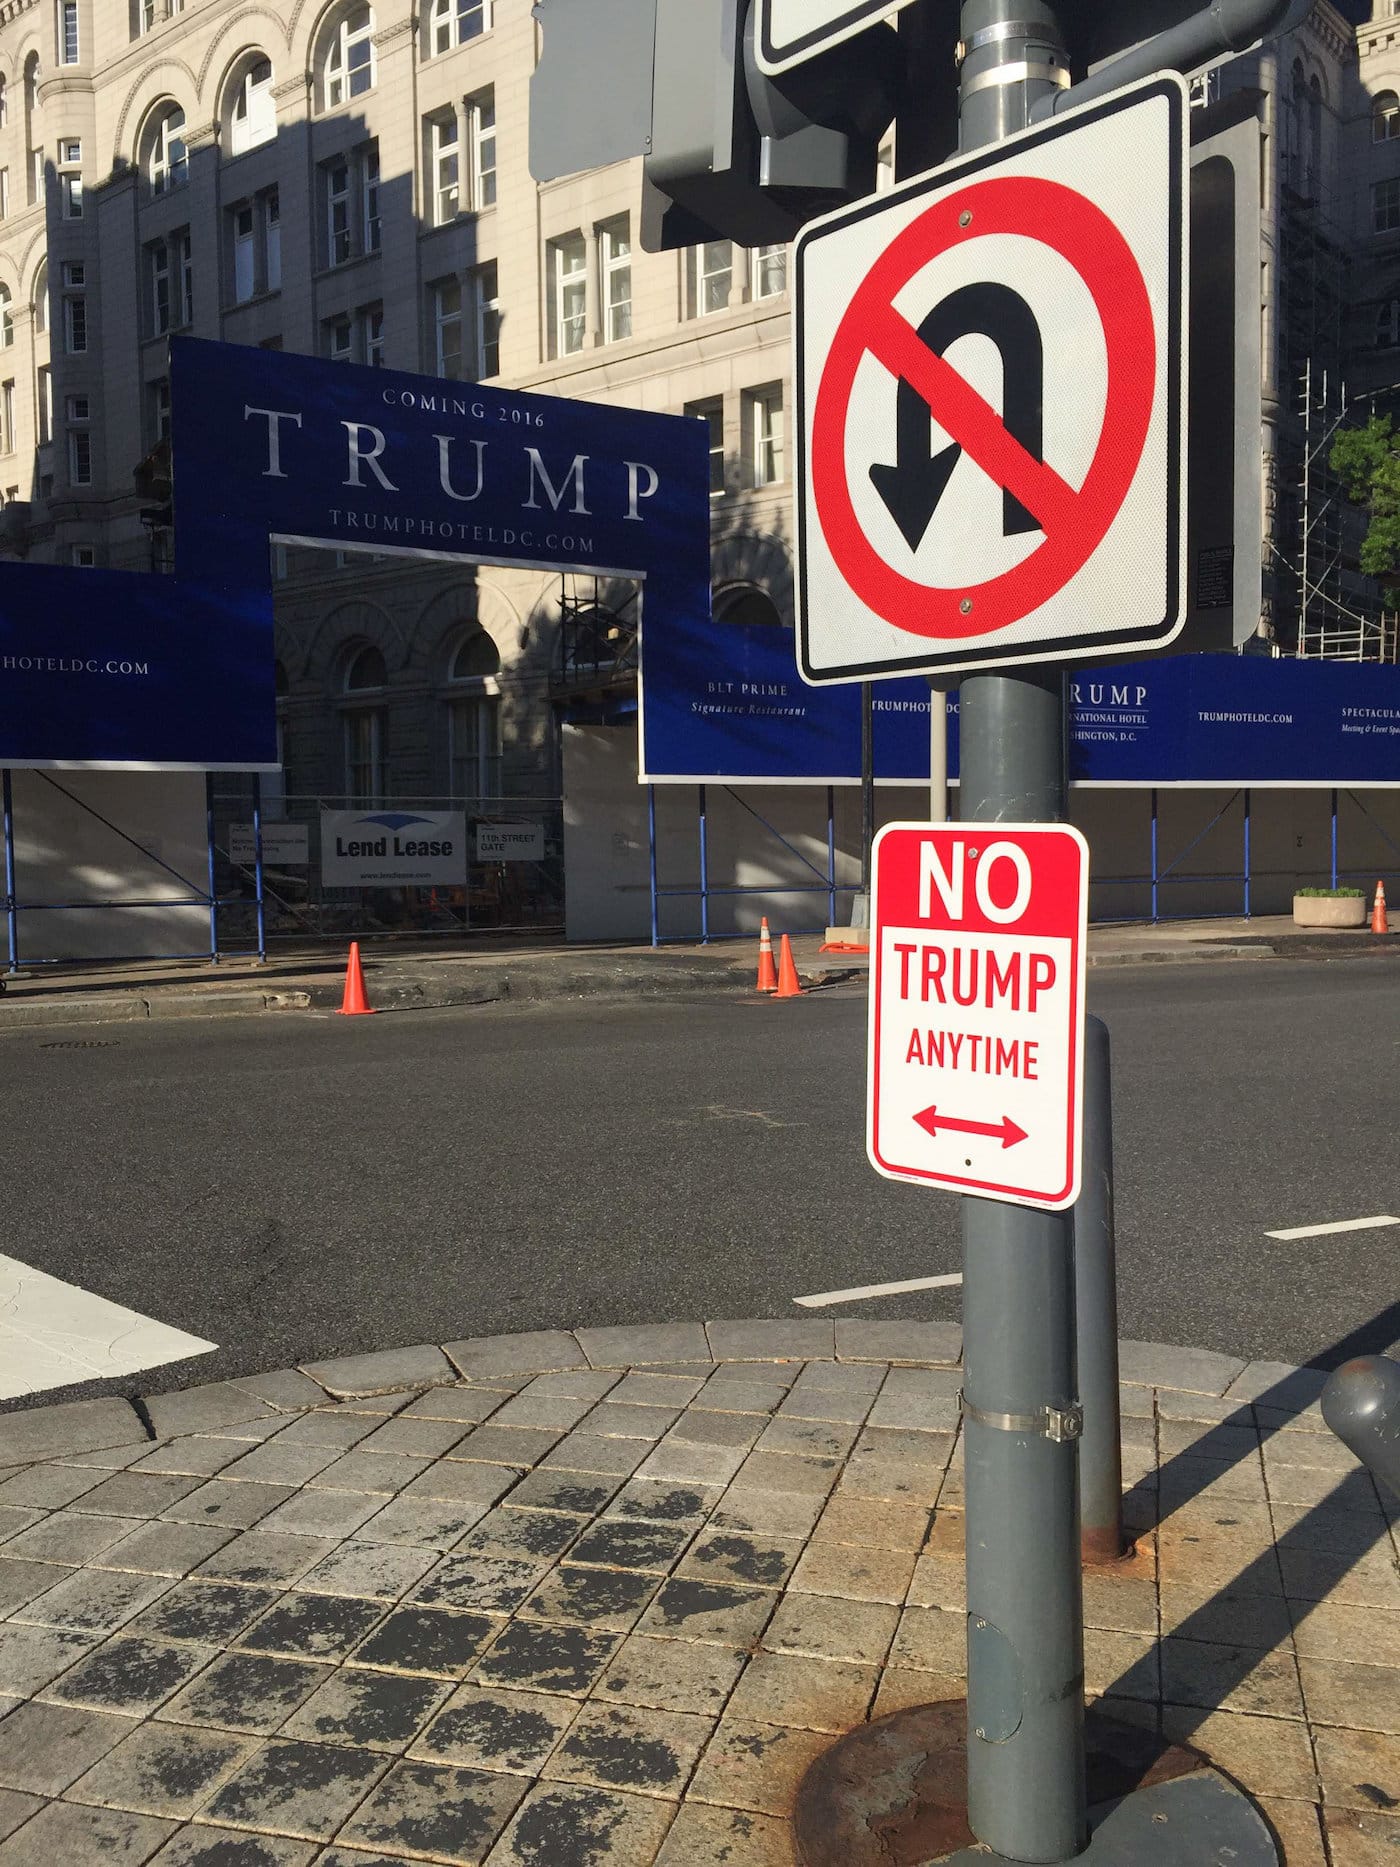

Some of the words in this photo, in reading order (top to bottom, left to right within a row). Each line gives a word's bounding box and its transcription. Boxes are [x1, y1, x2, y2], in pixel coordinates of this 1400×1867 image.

[383, 388, 485, 420] COMING
[498, 406, 545, 428] 2016
[243, 403, 660, 522] TRUMP
[328, 508, 595, 554] TRUMPHOTELDC.COM
[2, 656, 149, 675] HOTELDC.COM
[708, 682, 733, 694] BLT
[742, 683, 787, 697] PRIME
[690, 702, 744, 715] Signature
[748, 704, 806, 717] Restaurant
[1198, 711, 1293, 724] TRUMPHOTELDC.COM
[1119, 713, 1147, 724] HOTEL
[1120, 731, 1137, 742] D.C.
[1372, 724, 1388, 734] Event
[336, 836, 387, 857] Lend
[393, 836, 453, 857] Lease
[480, 843, 505, 851] GATE
[501, 834, 536, 843] STREET
[918, 840, 1032, 925] NO
[893, 943, 1057, 1014] TRUMP
[906, 1028, 1040, 1081] ANYTIME
